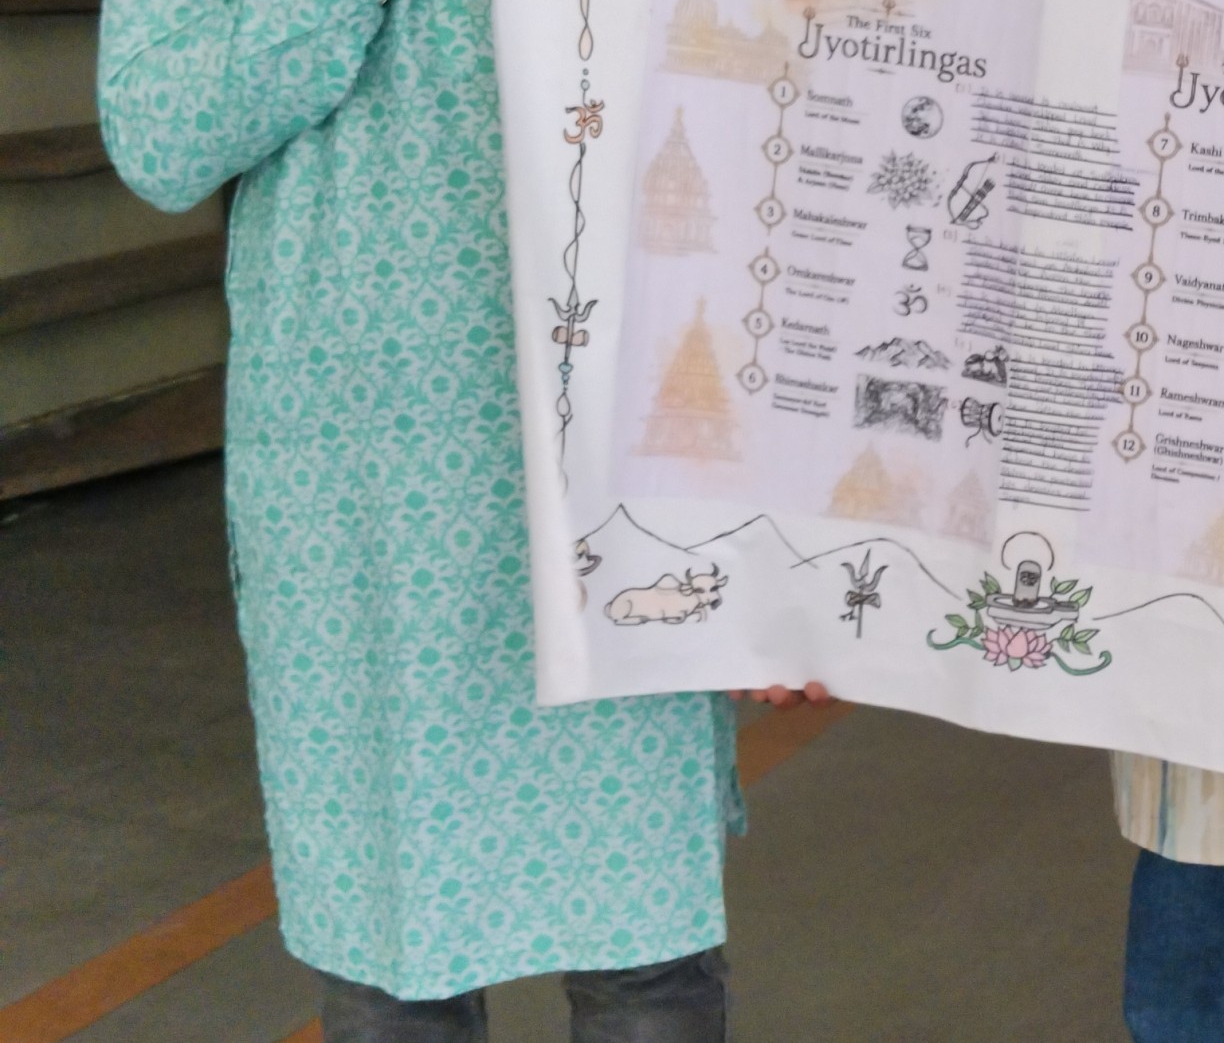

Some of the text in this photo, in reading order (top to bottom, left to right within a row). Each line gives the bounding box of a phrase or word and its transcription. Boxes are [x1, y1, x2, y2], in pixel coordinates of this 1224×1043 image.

[847, 15, 932, 39] The First Six
[798, 22, 987, 82] Jyotirlingas
[1190, 141, 1221, 157] Kashi
[1167, 334, 1224, 354] Nageshwar
[1155, 432, 1223, 453] Grishneshwar
